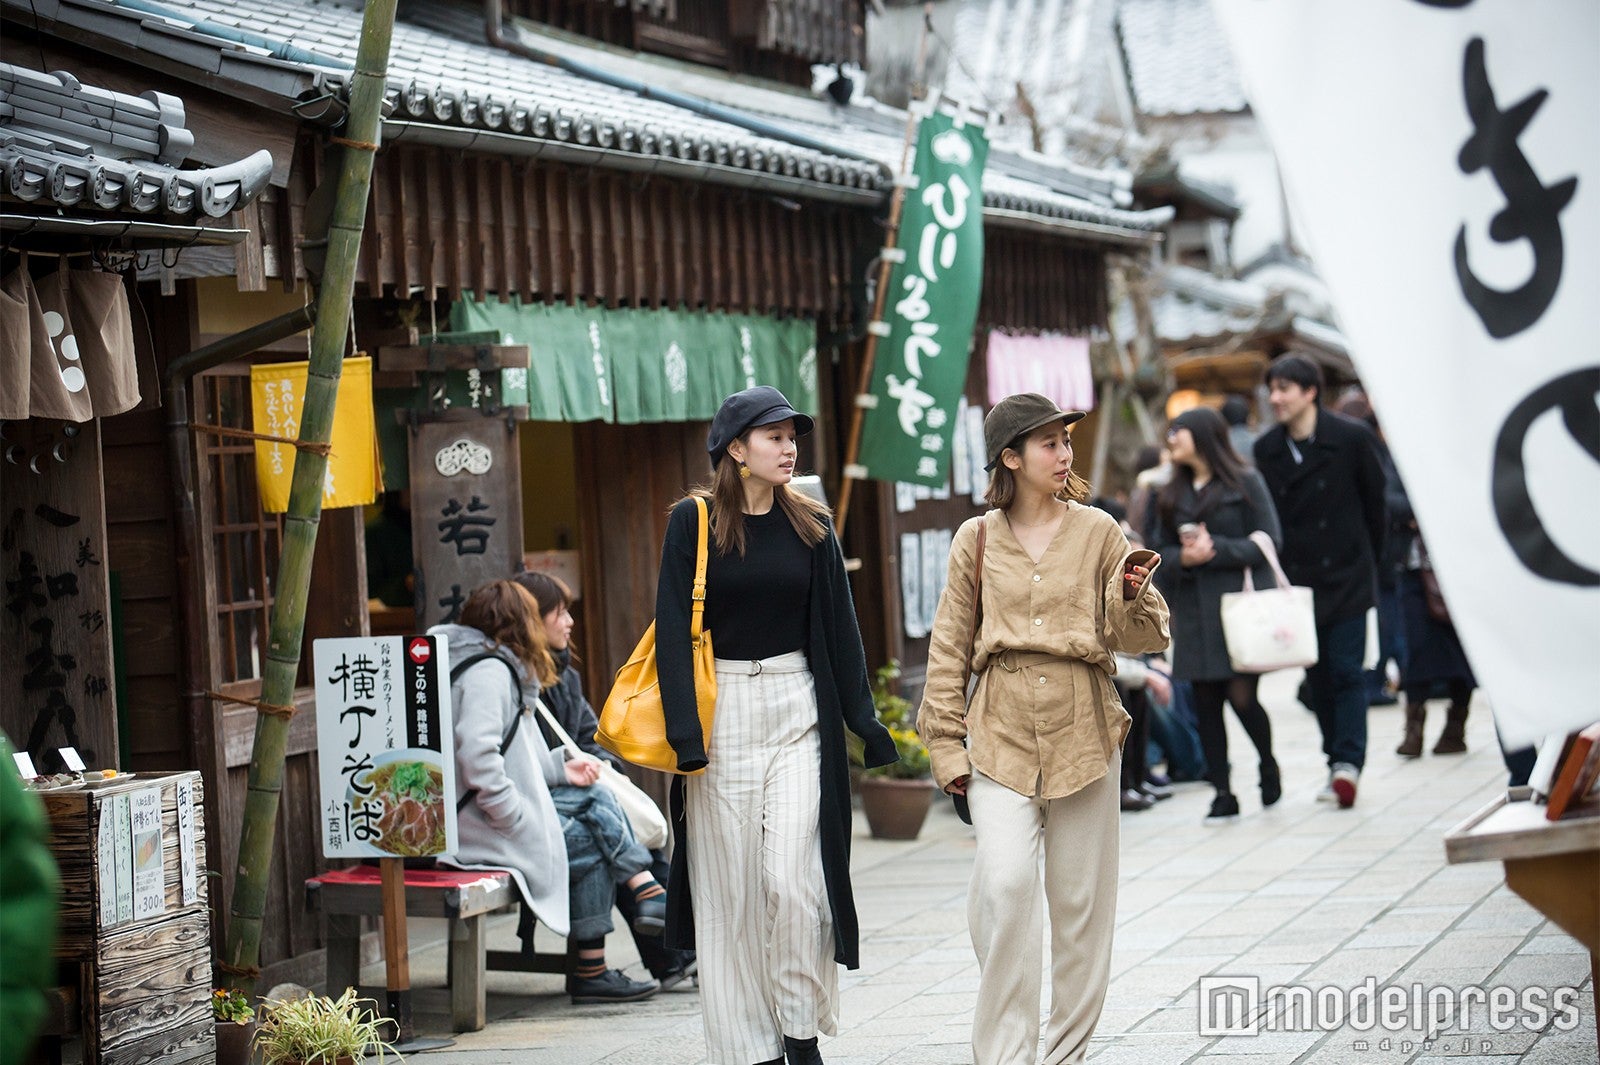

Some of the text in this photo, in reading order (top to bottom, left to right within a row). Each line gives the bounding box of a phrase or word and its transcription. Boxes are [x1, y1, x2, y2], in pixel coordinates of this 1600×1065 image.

[76, 536, 109, 698] 美杉郷
[328, 652, 384, 843] 横丁そば
[379, 642, 396, 750] 路地裏のラーメン屋
[414, 665, 430, 746] この先 路地奥
[178, 785, 192, 880] 缶ビール
